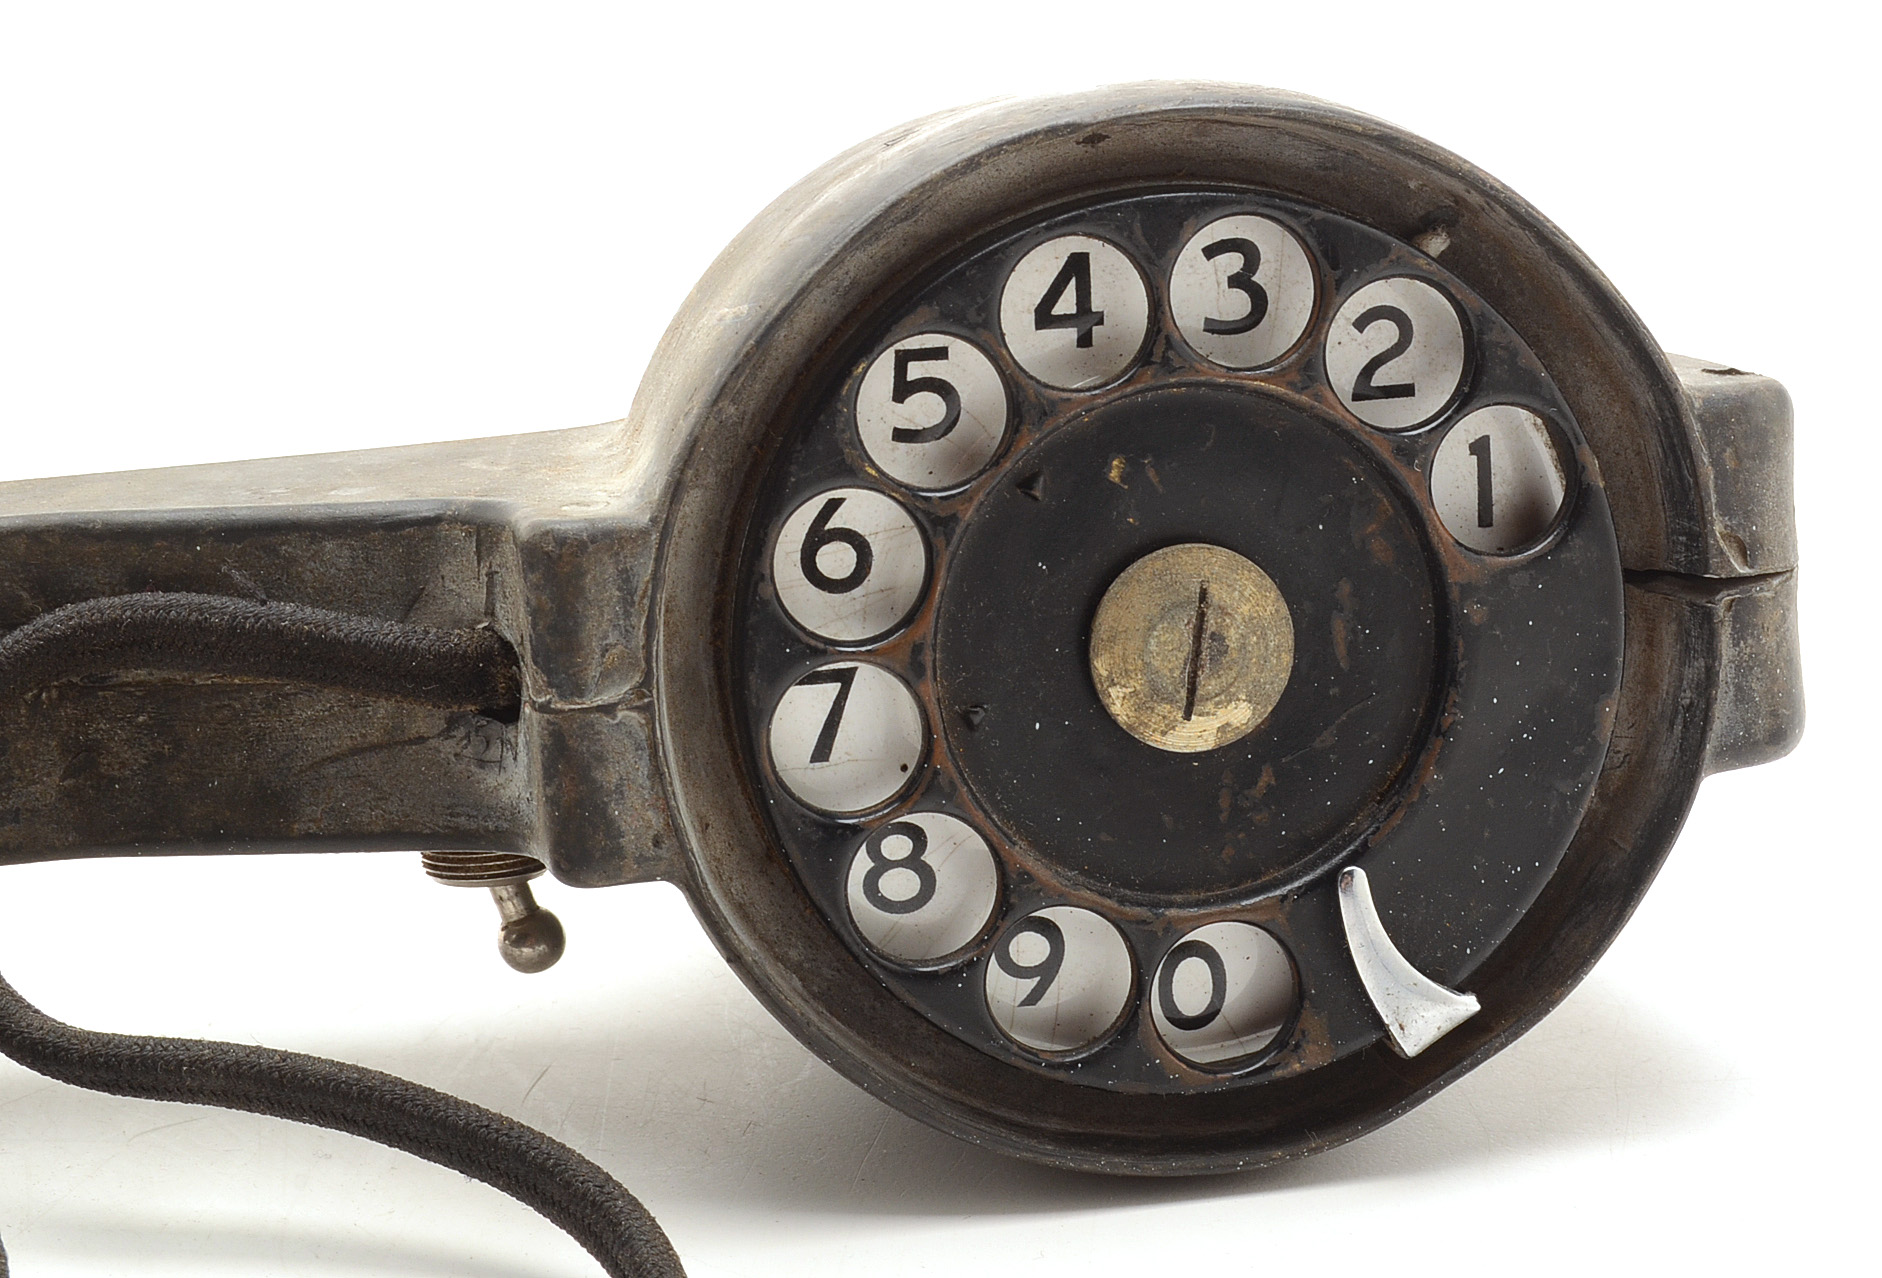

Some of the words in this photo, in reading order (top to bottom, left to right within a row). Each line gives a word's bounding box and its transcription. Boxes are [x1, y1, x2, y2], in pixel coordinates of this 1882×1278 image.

[1034, 252, 1104, 349] 4
[1201, 238, 1268, 335] 3
[892, 346, 961, 443] 5
[1351, 305, 1415, 402] 2
[1468, 434, 1494, 528] 1
[800, 498, 873, 594] 6
[794, 666, 859, 763] 7
[862, 821, 937, 914] 8
[995, 916, 1065, 1007] 9
[1158, 940, 1227, 1031] 0
